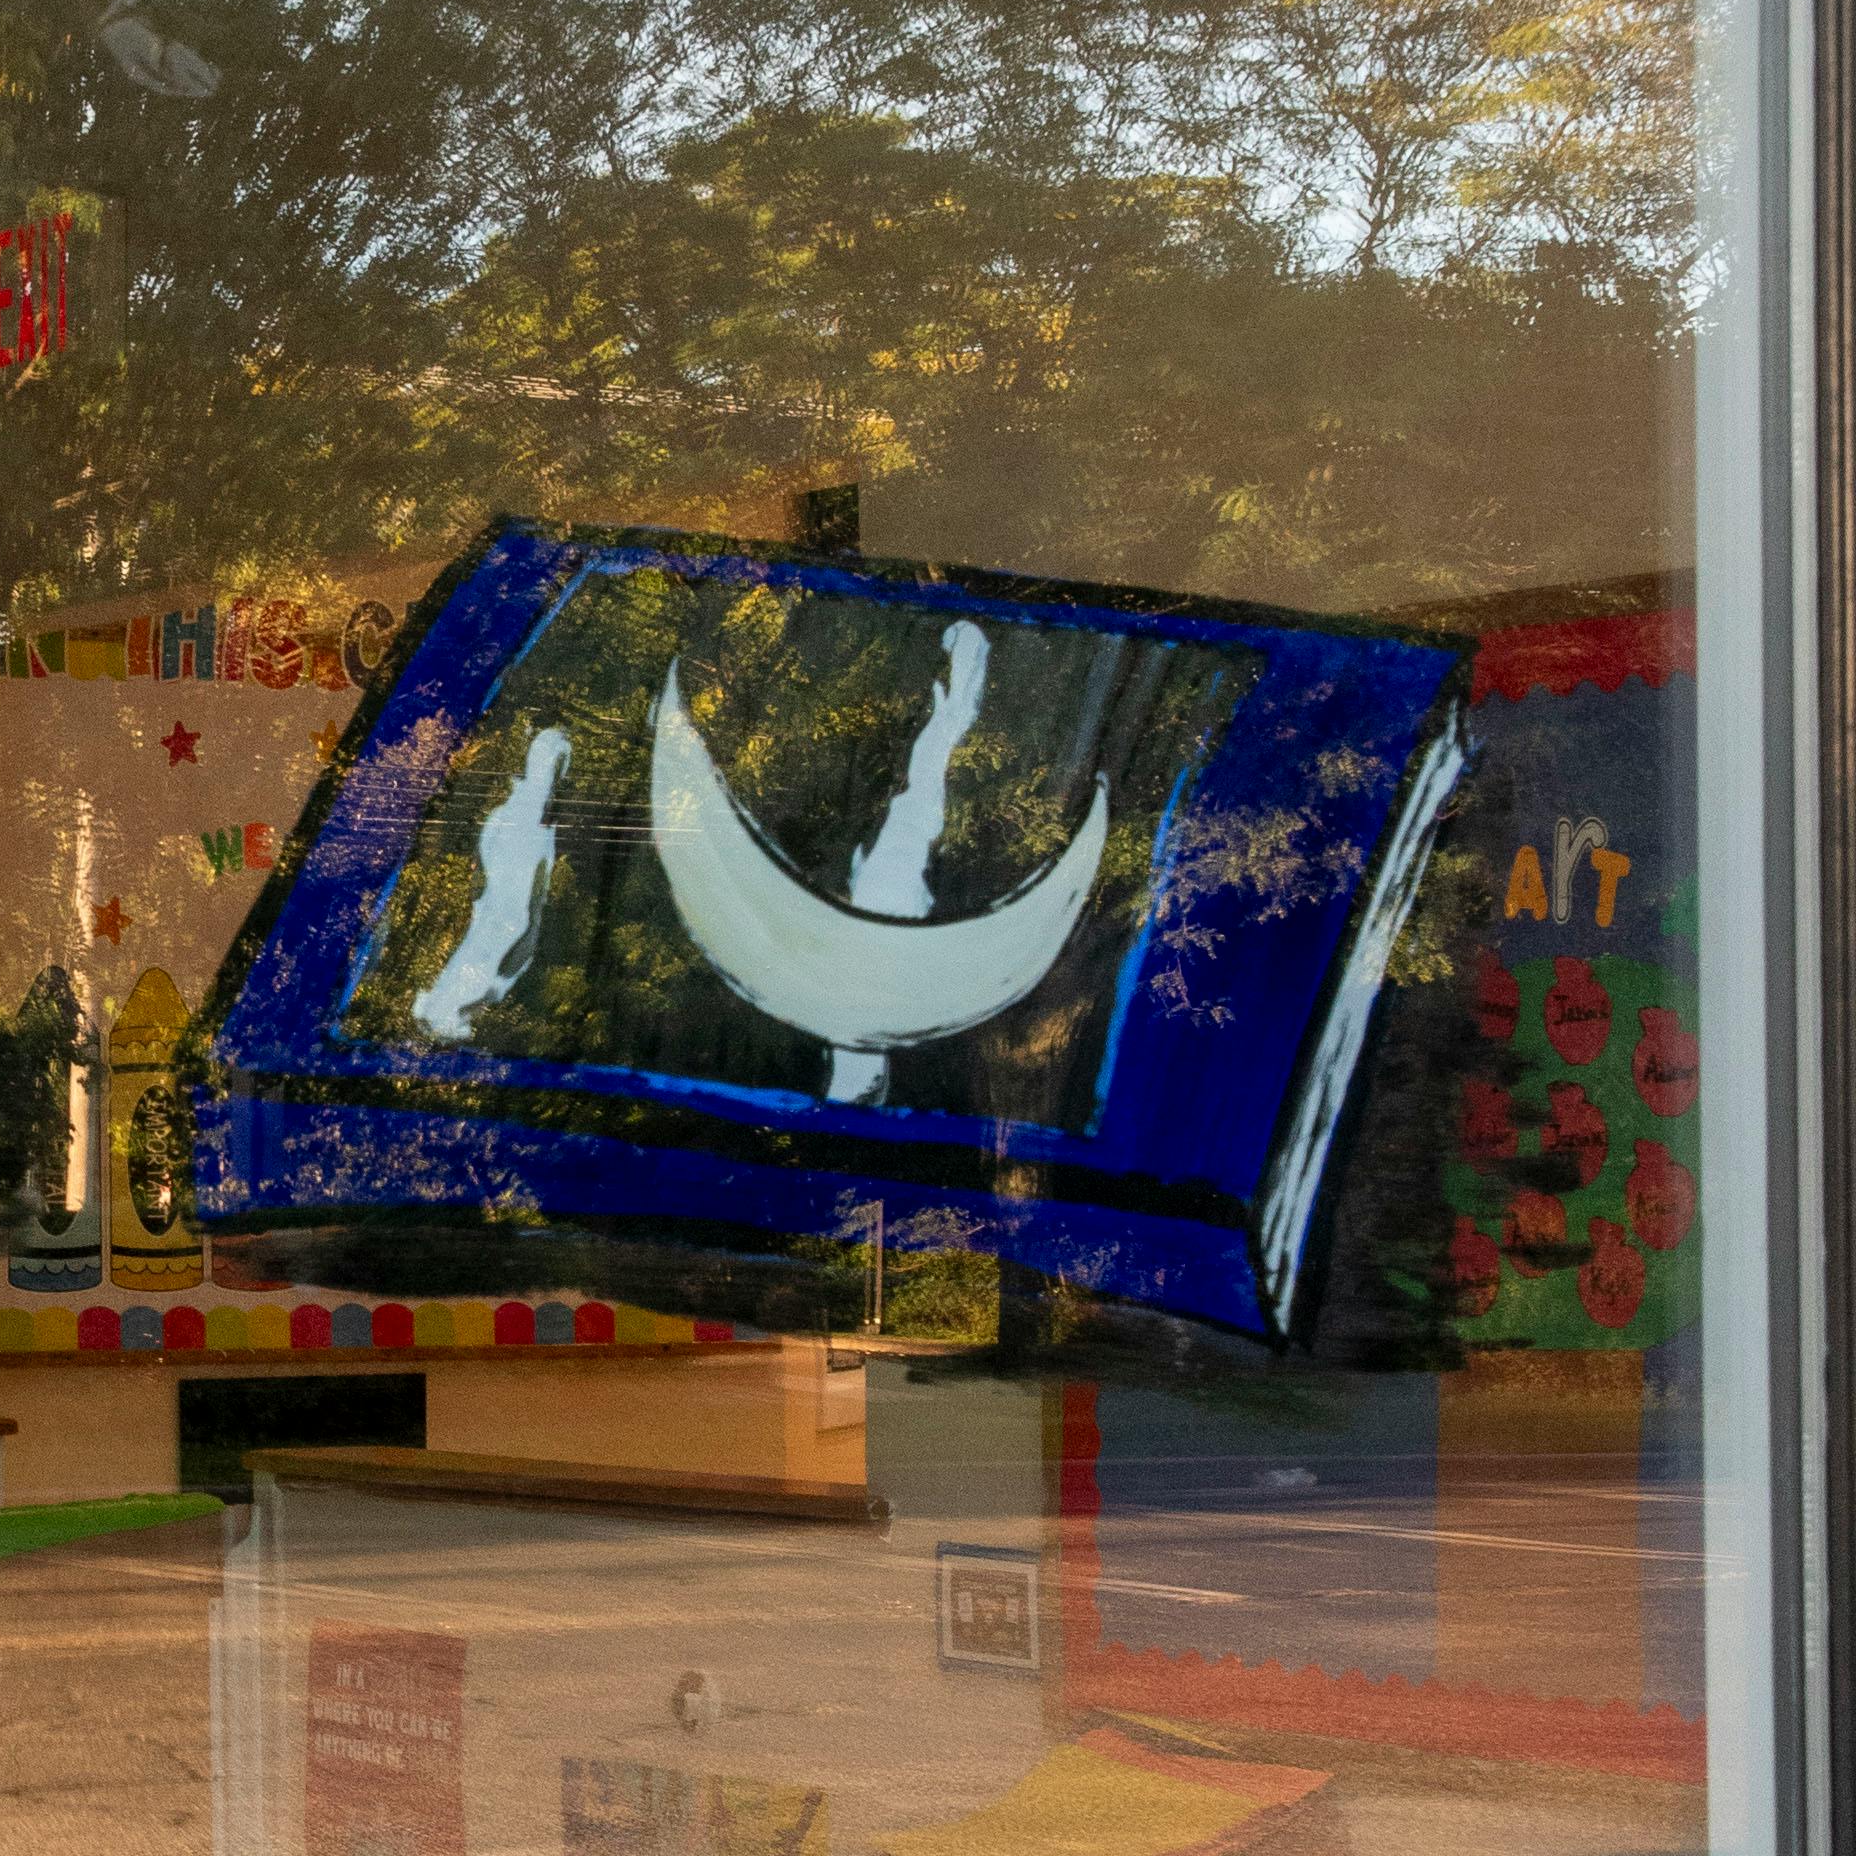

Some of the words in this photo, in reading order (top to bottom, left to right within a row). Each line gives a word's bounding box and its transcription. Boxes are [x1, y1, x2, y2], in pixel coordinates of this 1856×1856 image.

[200, 821, 280, 877] WE
[146, 1098, 172, 1223] IMPORTANT
[365, 1705, 395, 1734] YOU
[398, 1710, 429, 1739] CAN
